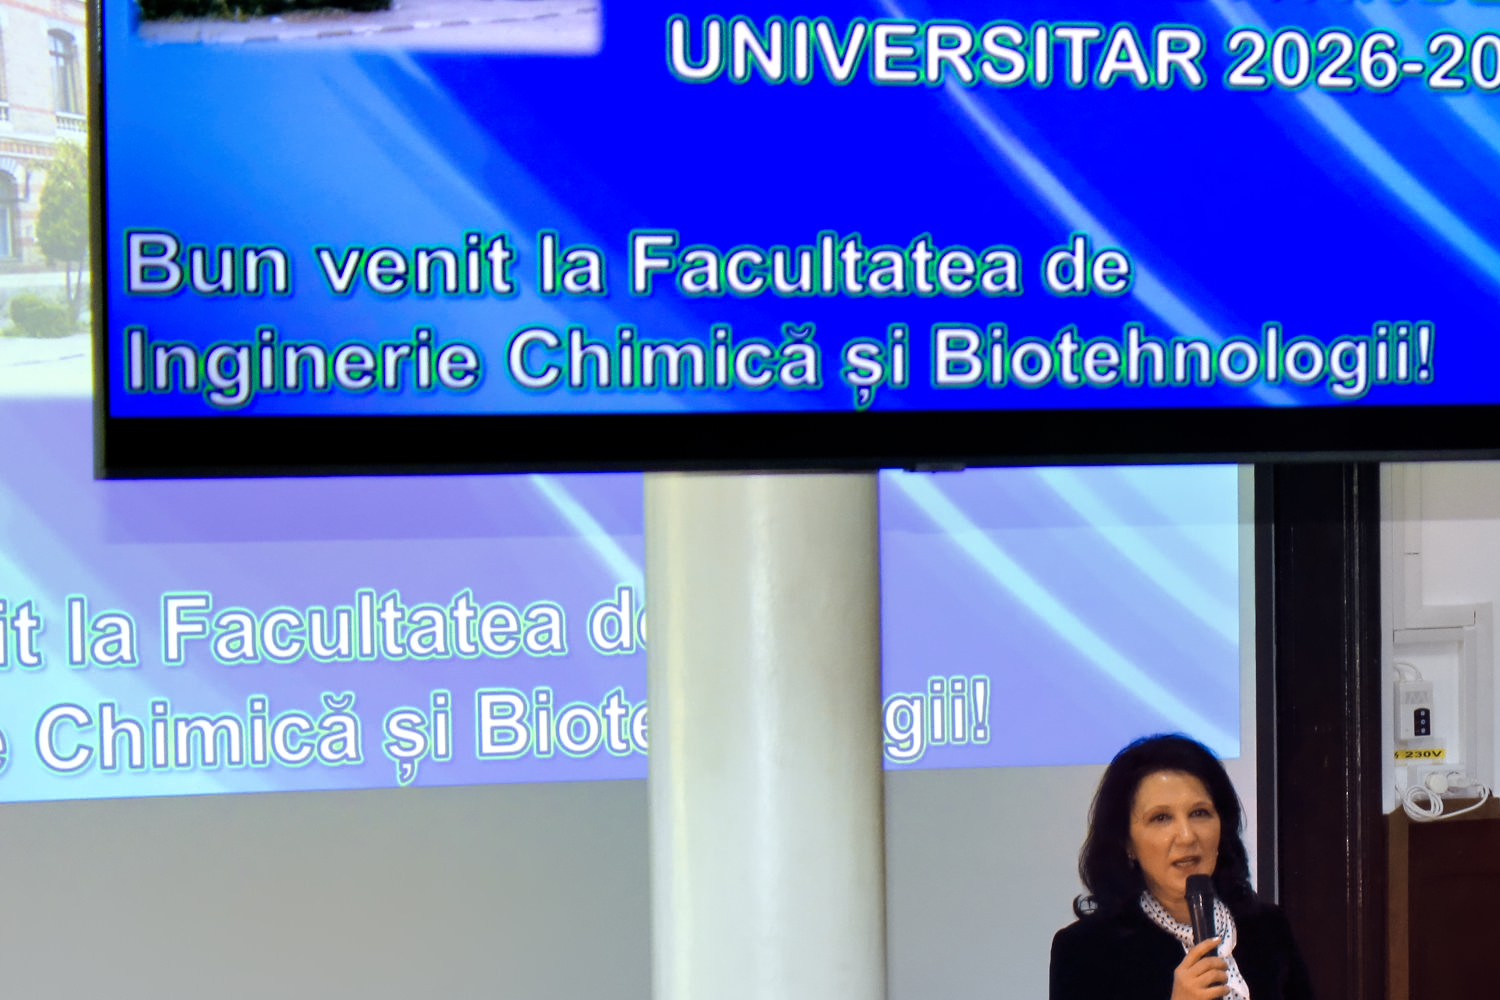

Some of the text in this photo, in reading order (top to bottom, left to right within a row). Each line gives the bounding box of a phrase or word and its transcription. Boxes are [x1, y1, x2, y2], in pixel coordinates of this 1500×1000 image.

[669, 17, 1204, 86] UNIVERSITAR
[127, 232, 1131, 295] Bun venit la Facultatea de
[128, 324, 1434, 407] Inginerie Chimică și Biotehnologii!
[70, 598, 136, 664] la
[164, 592, 564, 663] Facultatea
[590, 587, 647, 652] d
[36, 693, 359, 772] Chimică
[387, 693, 449, 783] și
[1405, 750, 1443, 758] 230V
